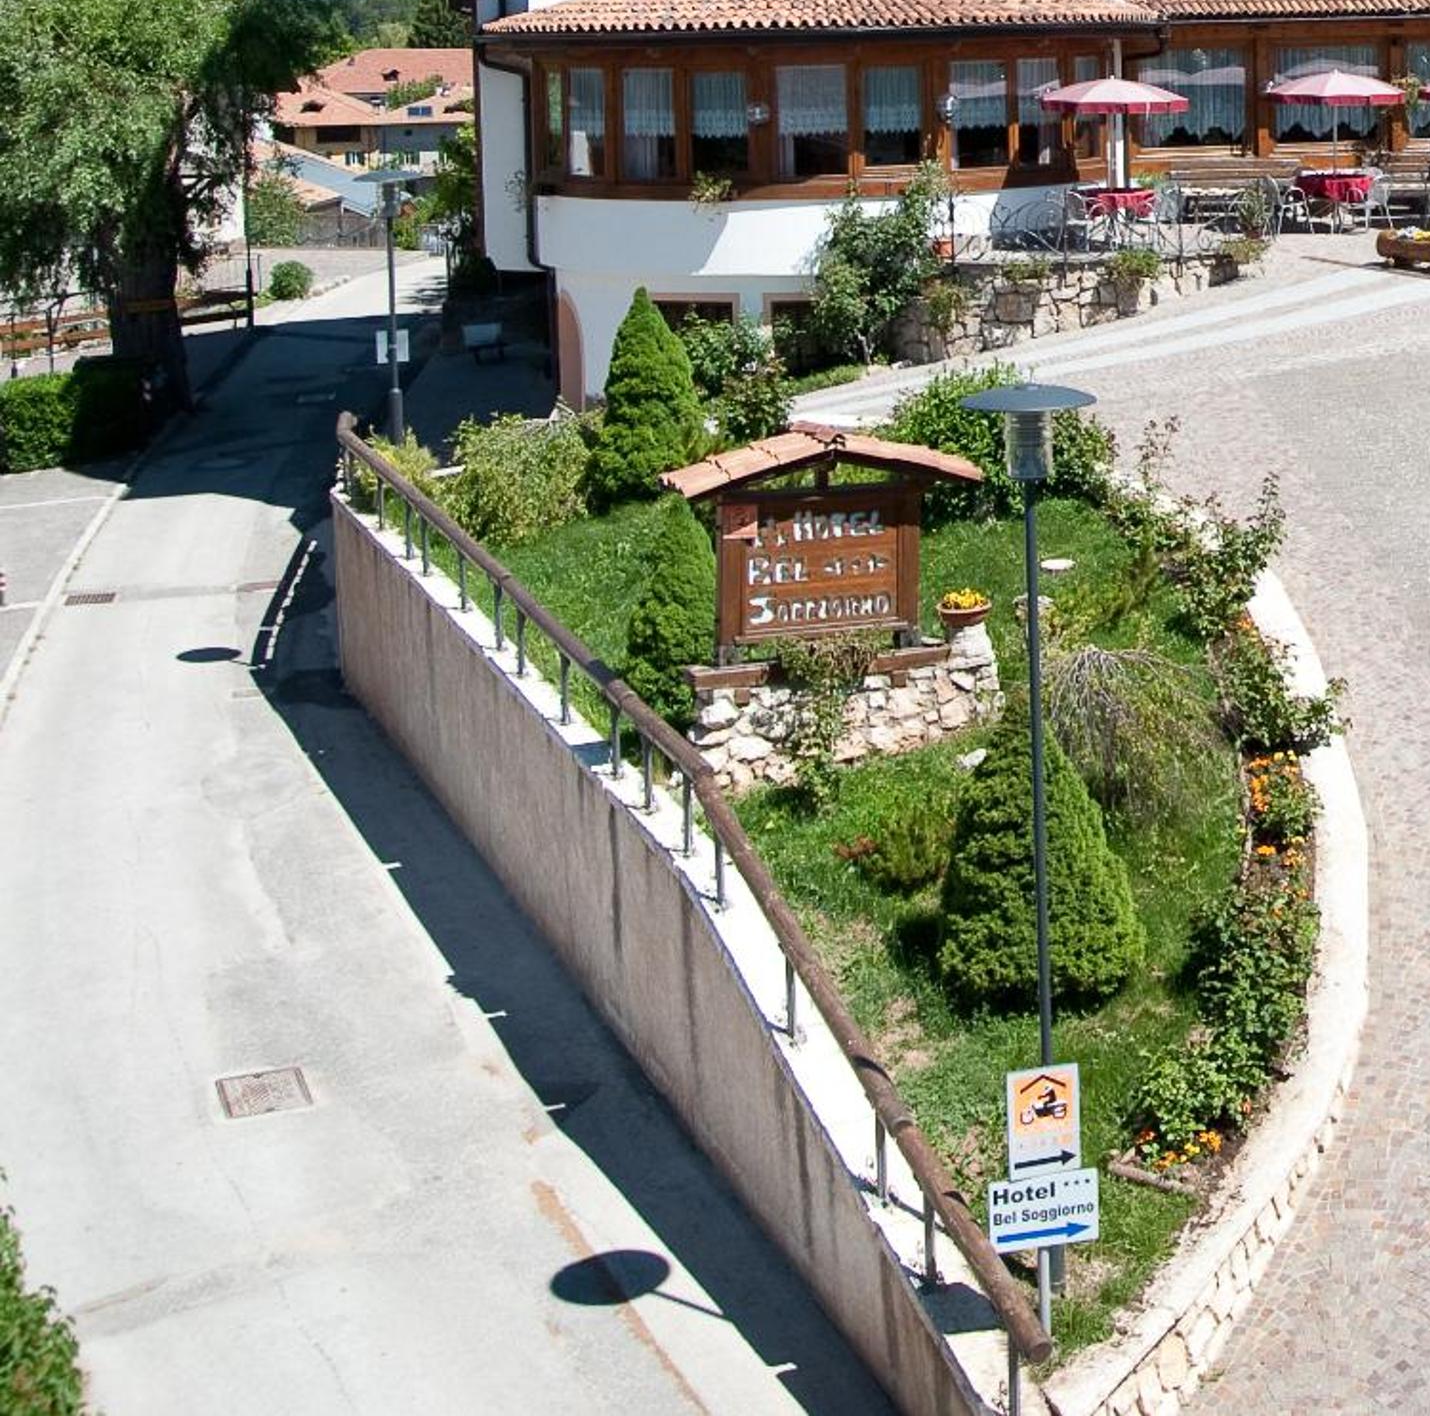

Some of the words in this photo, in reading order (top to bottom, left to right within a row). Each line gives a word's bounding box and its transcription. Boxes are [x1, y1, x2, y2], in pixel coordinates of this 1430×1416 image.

[993, 1182, 1056, 1206] Hotel
[993, 1211, 1017, 1227] Bel
[1022, 1202, 1095, 1223] Soggiorno
